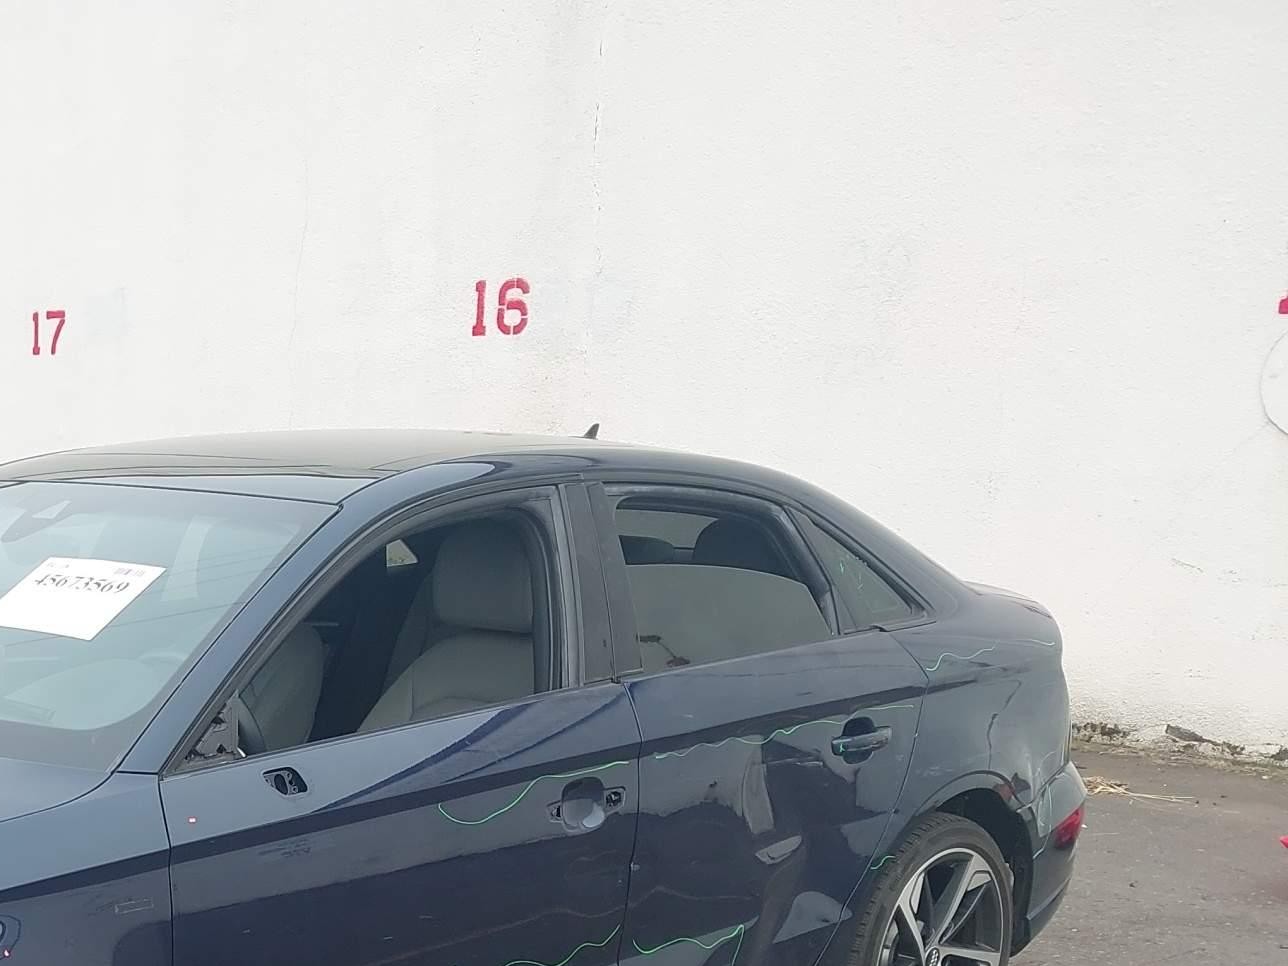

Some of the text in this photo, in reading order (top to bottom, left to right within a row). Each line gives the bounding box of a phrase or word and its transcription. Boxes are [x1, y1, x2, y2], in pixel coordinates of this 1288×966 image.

[472, 277, 530, 336] 16
[32, 309, 65, 355] 17
[34, 573, 131, 594] 45673569
